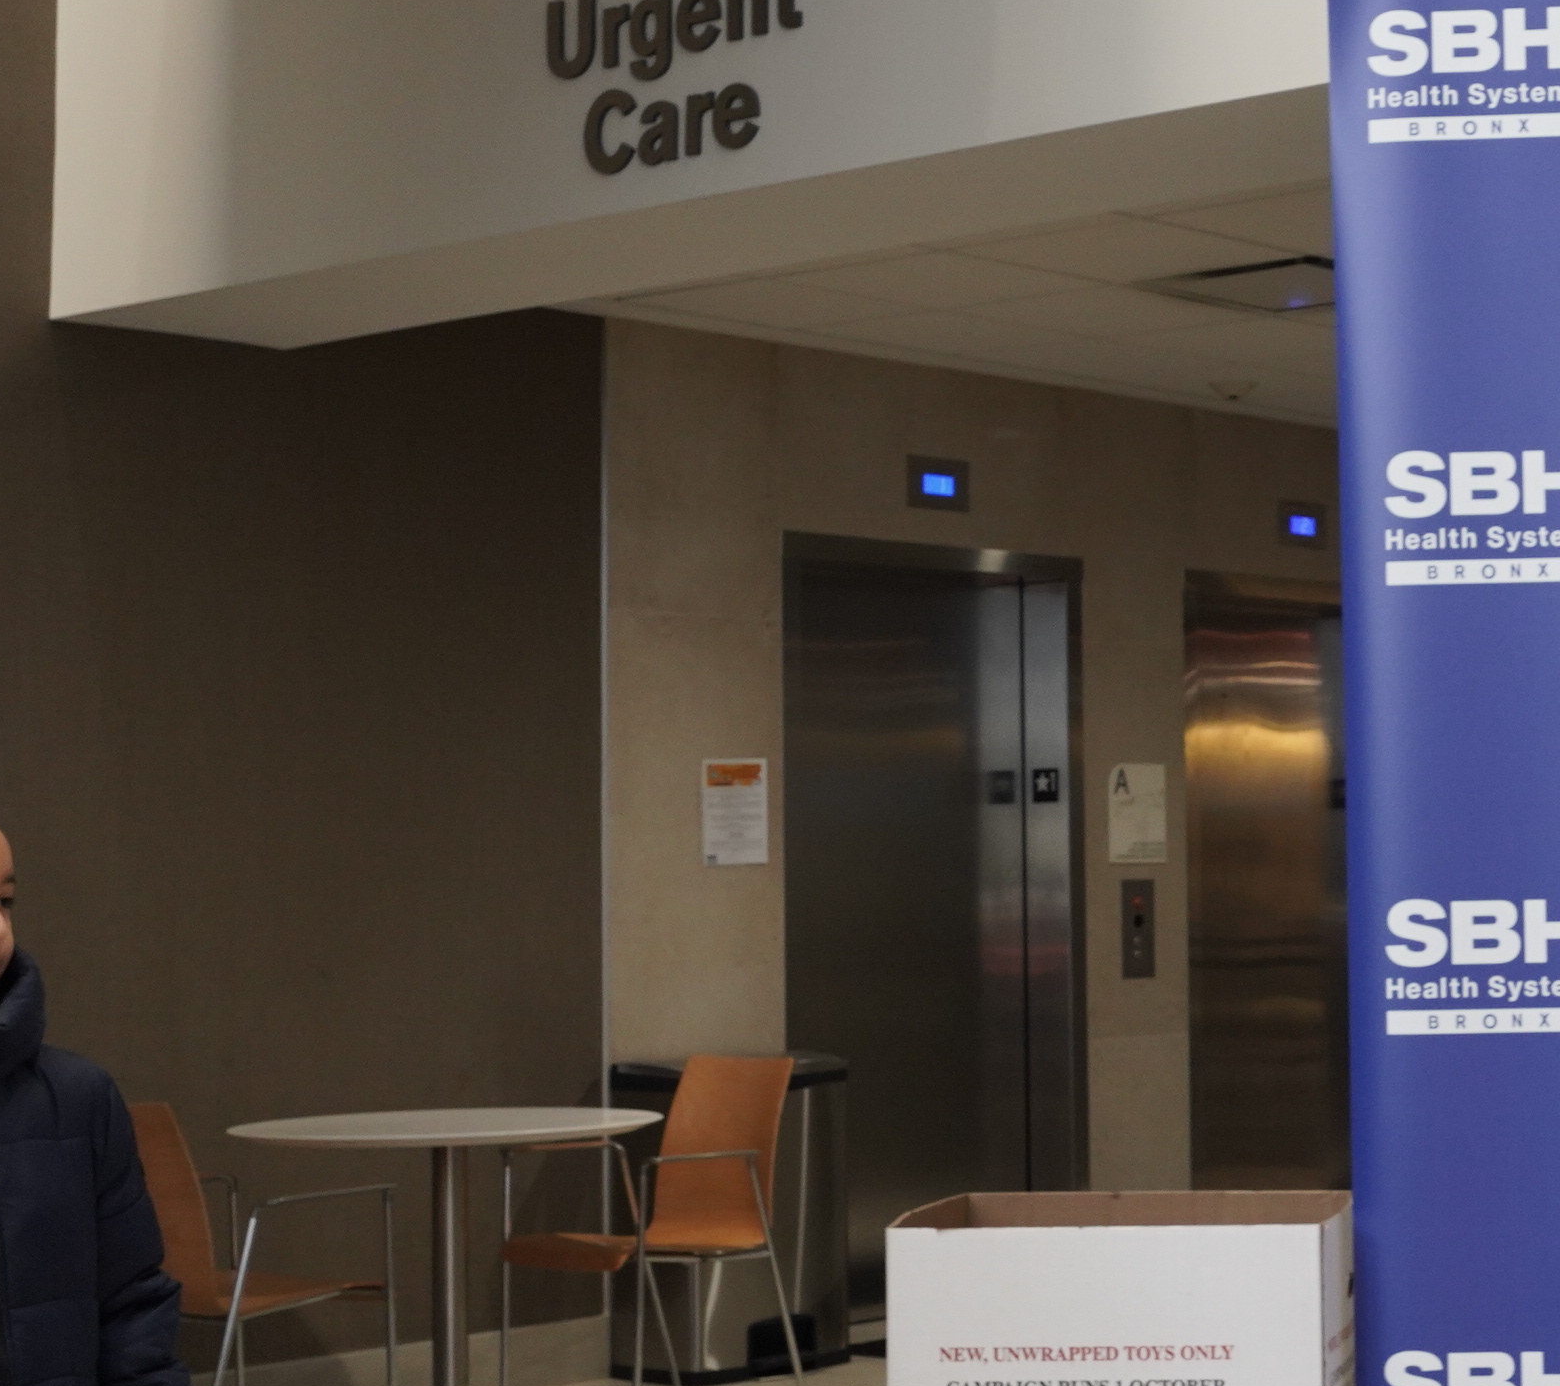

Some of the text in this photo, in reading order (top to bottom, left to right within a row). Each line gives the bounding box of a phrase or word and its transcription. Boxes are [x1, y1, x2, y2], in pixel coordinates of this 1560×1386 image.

[1366, 85, 1458, 110] Health
[584, 82, 762, 175] Care
[1408, 119, 1528, 136] BRONX
[1385, 527, 1477, 550] Health
[1426, 563, 1548, 580] BRONX
[1386, 977, 1478, 999] Health
[1427, 1013, 1550, 1030] BRONX
[940, 1345, 1236, 1364] NEW, UNWRAPPED TOYS ONLY
